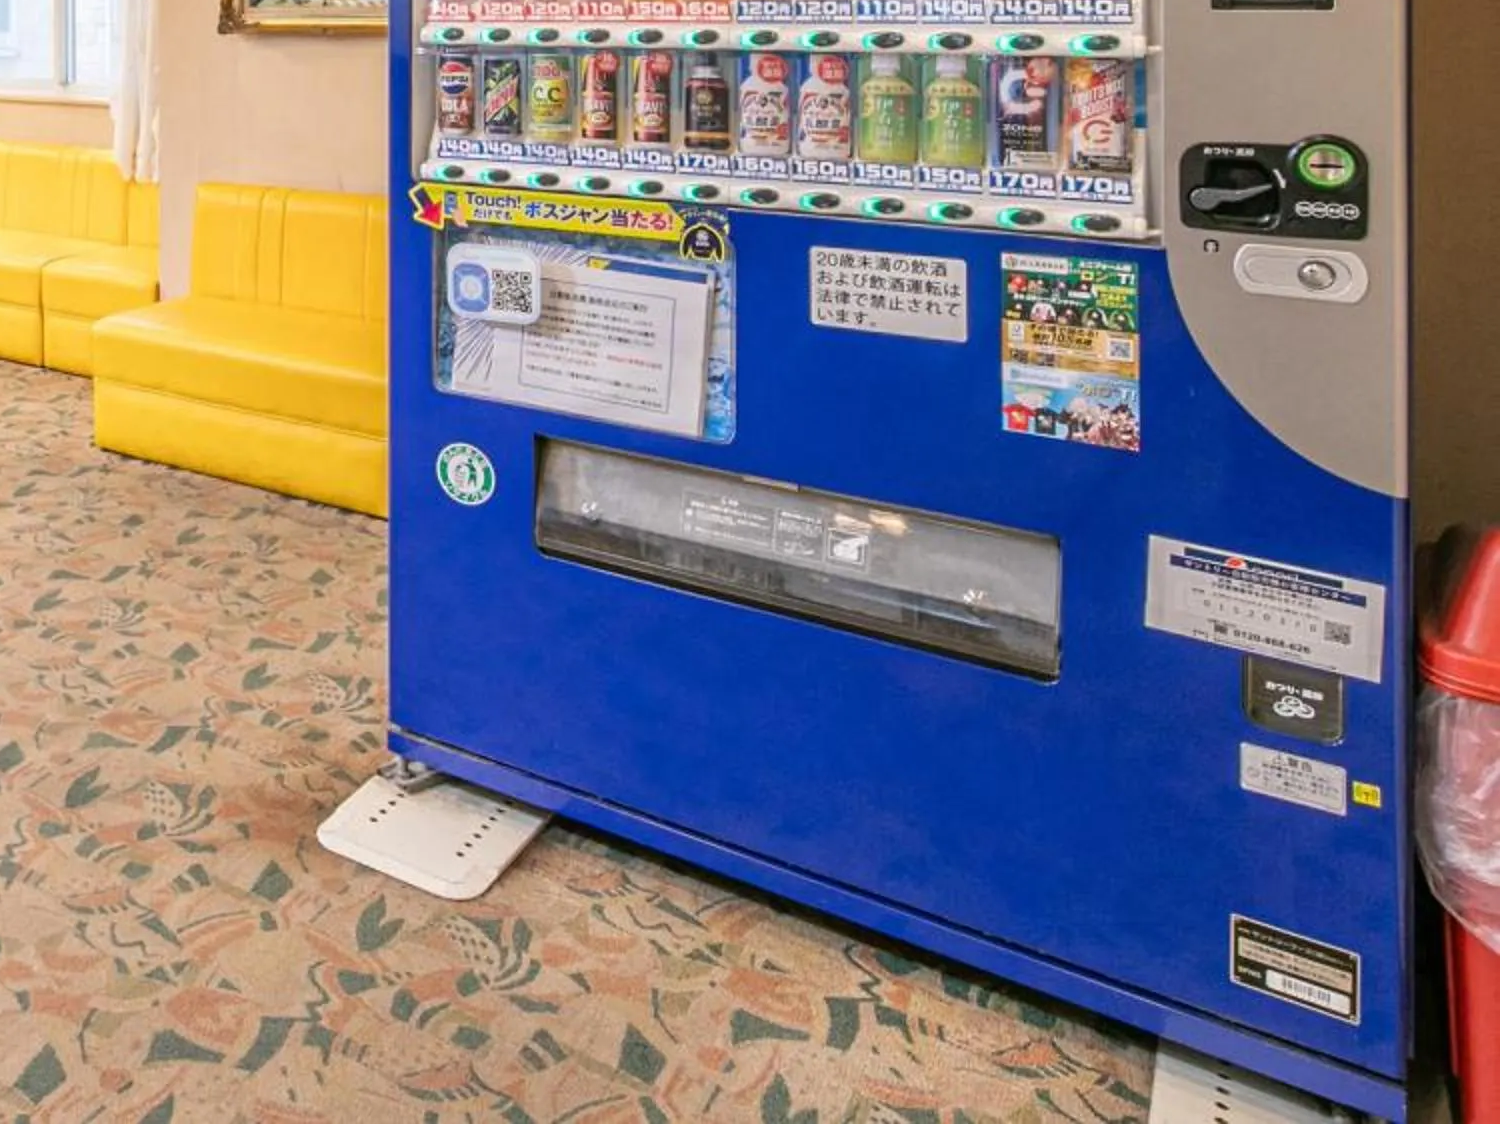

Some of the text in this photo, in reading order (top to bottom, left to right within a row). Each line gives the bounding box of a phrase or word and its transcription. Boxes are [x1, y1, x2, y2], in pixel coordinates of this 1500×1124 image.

[739, 0, 791, 15] 120円
[799, 0, 851, 15] 120円
[859, 0, 915, 15] 110円
[925, 0, 983, 15] 140円
[994, 0, 1058, 15] 140円
[1063, 0, 1129, 15] 140円
[920, 168, 981, 185] 150円
[994, 173, 1054, 189] 170円
[1064, 177, 1130, 194] 170円
[465, 191, 521, 209] Touch!
[473, 208, 513, 222] だけでも
[524, 202, 674, 231] ボスジャン当たる!
[816, 251, 947, 277] 20歳未満の飲酒
[816, 272, 962, 299] および飲酒運転は
[816, 290, 962, 318] 法律で禁止されて
[816, 308, 877, 327] います。
